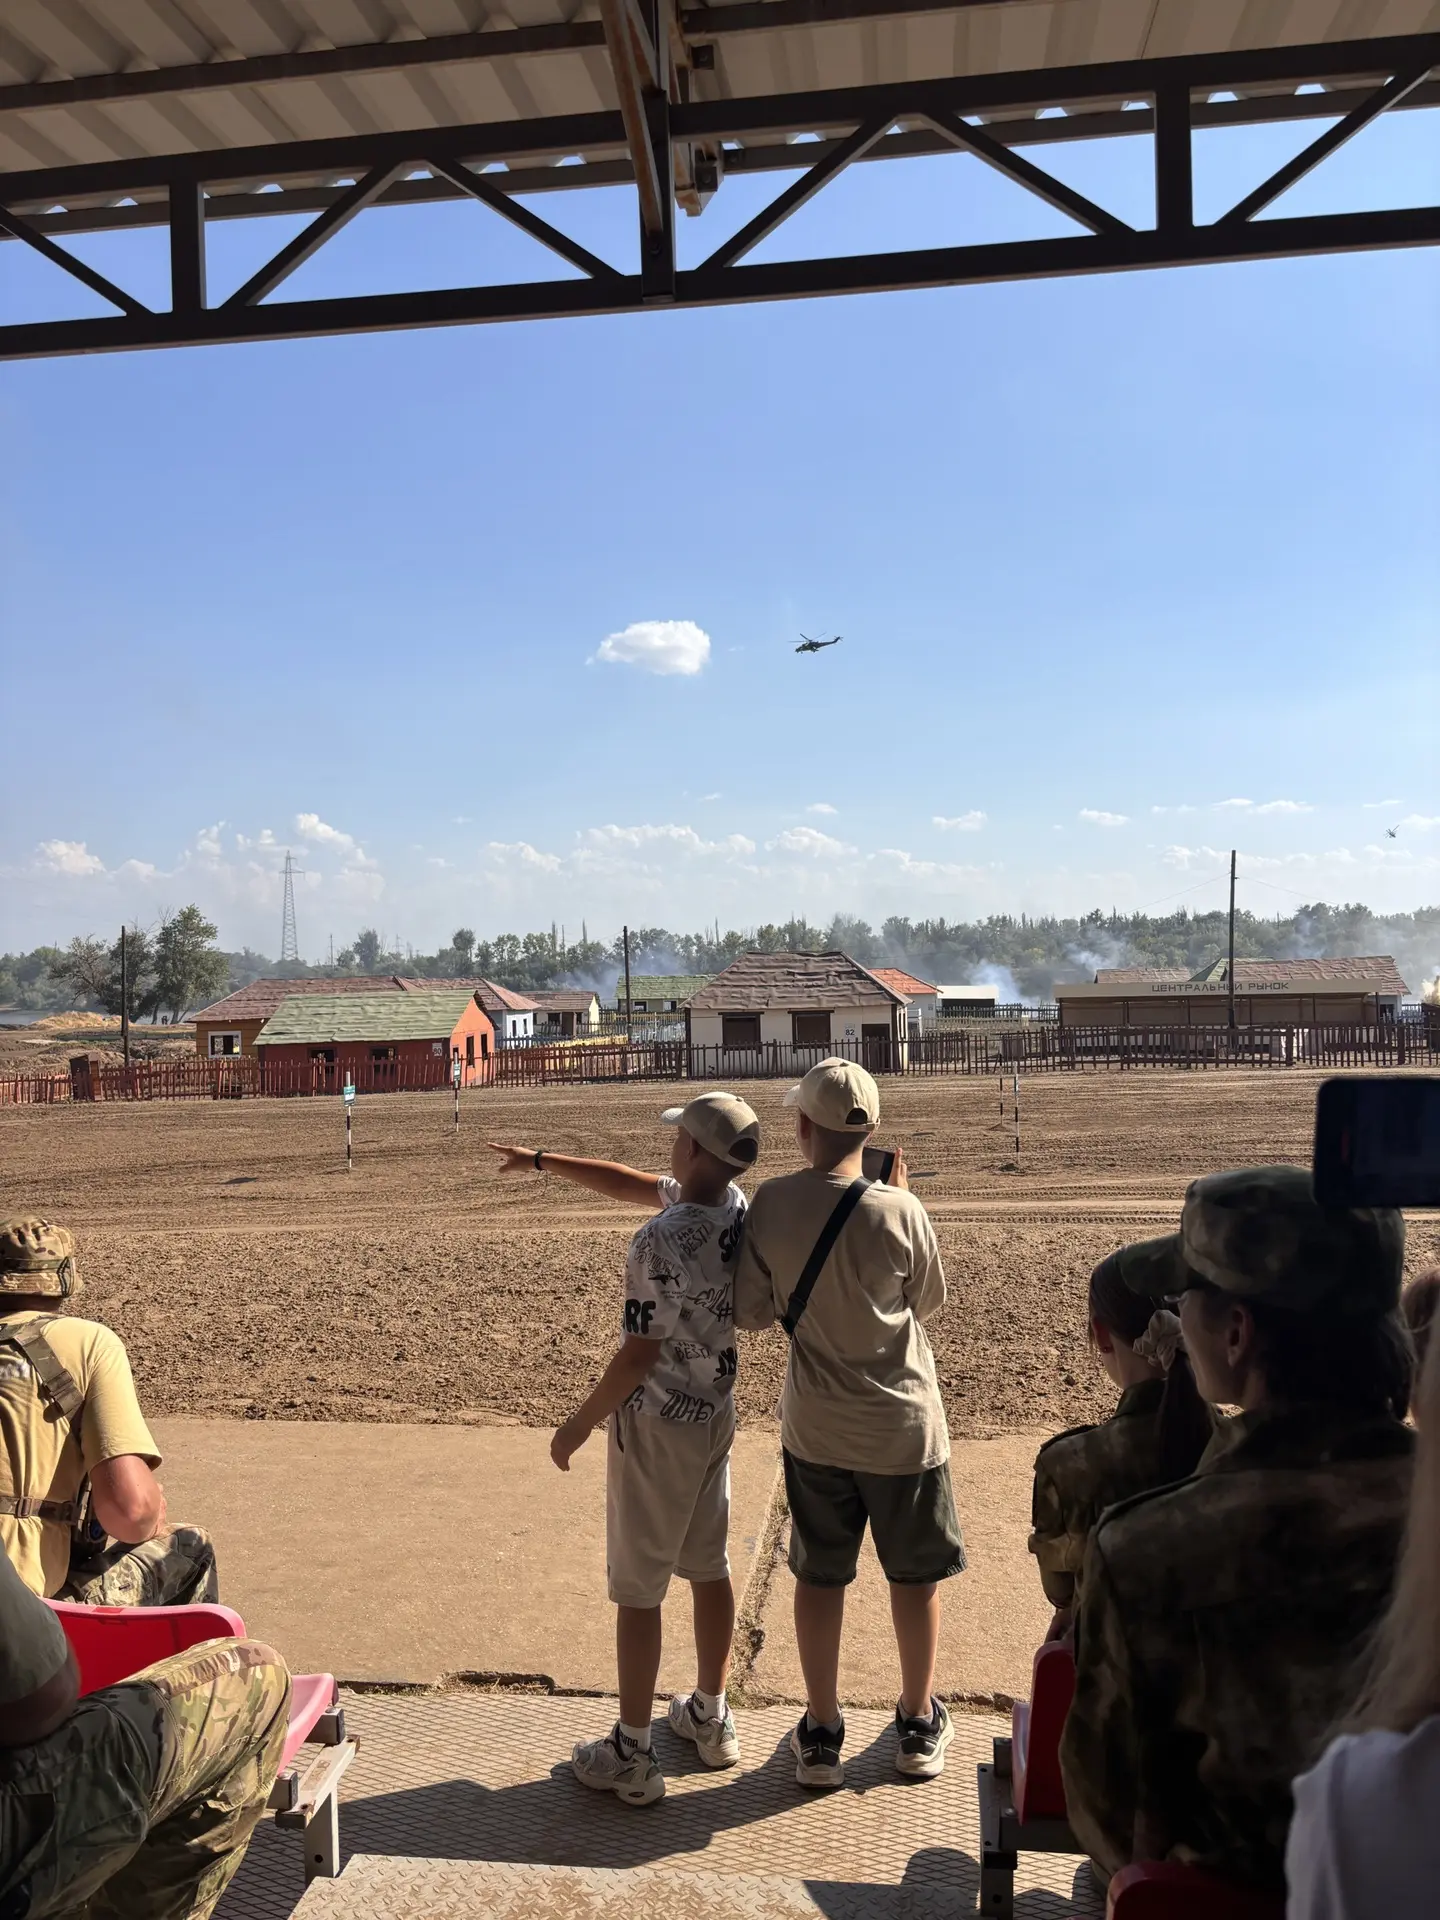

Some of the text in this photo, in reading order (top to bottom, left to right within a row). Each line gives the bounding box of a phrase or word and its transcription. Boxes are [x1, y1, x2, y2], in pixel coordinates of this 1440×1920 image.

[1248, 982, 1289, 991] РЫНОК
[845, 1028, 855, 1036] 82
[677, 1227, 695, 1241] the
[623, 1298, 656, 1335] RF
